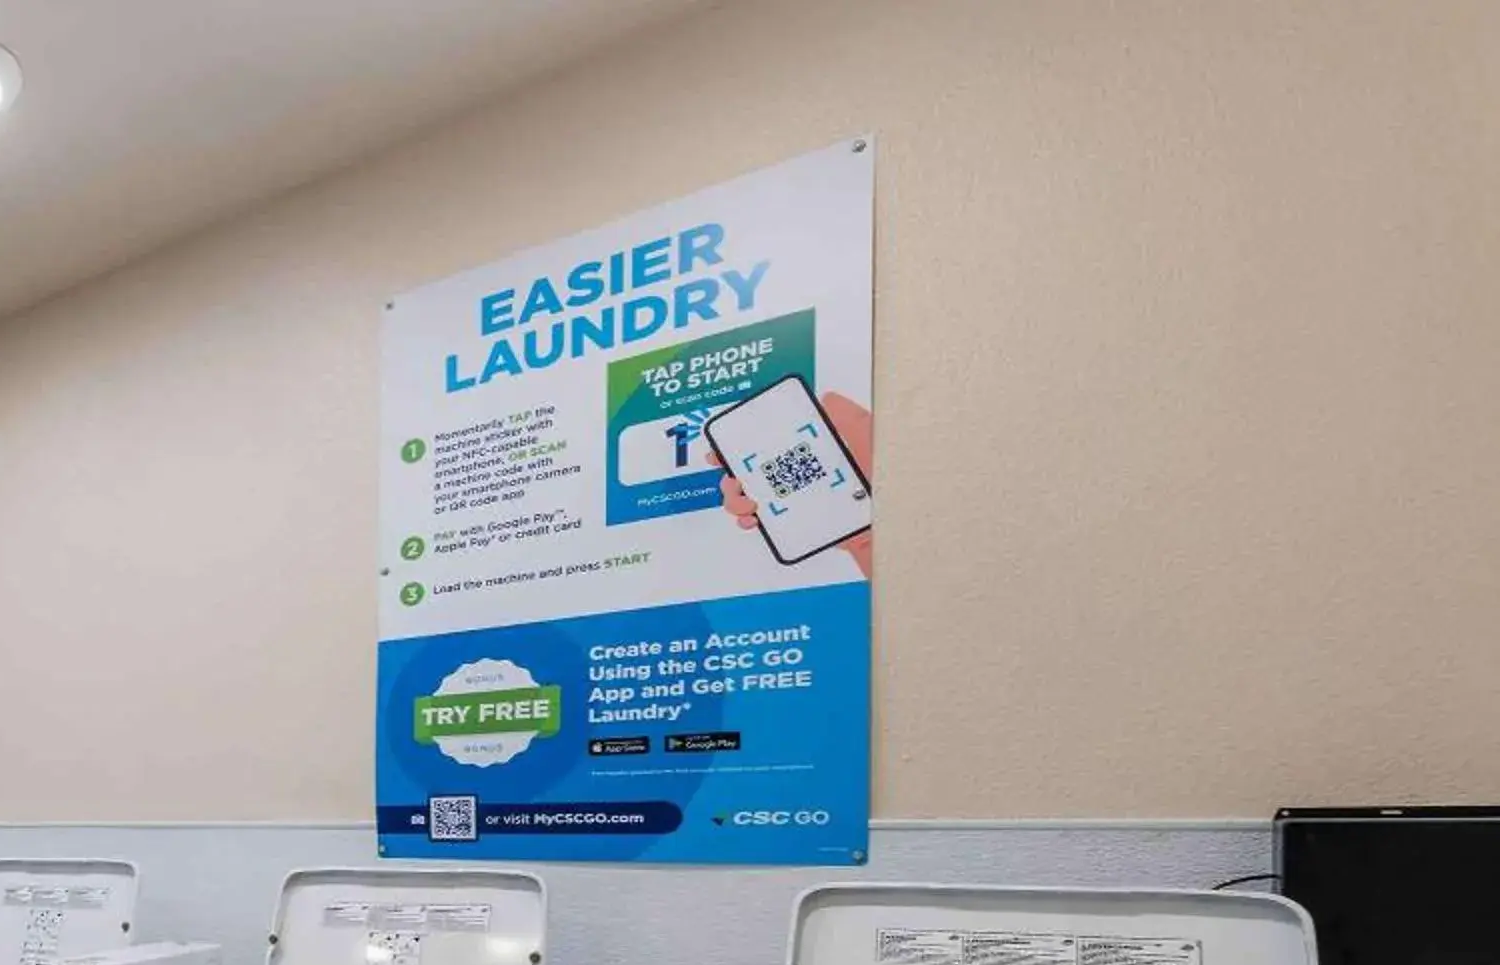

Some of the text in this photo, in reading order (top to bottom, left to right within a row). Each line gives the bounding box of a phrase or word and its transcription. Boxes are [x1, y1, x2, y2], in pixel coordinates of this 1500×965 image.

[481, 221, 725, 336] EASIER
[445, 259, 772, 393] LAUNDRY
[641, 338, 774, 384] TAP PHONE
[652, 357, 763, 397] TO START
[660, 385, 734, 409] or scan code
[434, 405, 555, 442] Momentarily TAP the
[434, 419, 553, 454] machine sticker with
[434, 436, 538, 469] your NFC-capable
[508, 451, 527, 462] OR
[530, 440, 567, 457] SCAN
[666, 422, 689, 468] 1
[434, 458, 553, 491] a machine code with
[434, 465, 581, 505] your smartphone camera
[434, 489, 525, 515] or QR code app
[434, 530, 457, 540] PAY
[460, 525, 484, 536] with
[487, 516, 530, 533] Google
[434, 541, 467, 554] Apple
[498, 533, 511, 542] or
[515, 525, 549, 539] credit
[553, 519, 582, 533] card
[433, 551, 652, 595] Load the machine and press START
[589, 624, 811, 661] Create an Account
[589, 648, 803, 681] Using the CSC GO
[588, 671, 812, 704] App and Get FREE
[421, 699, 550, 726] TRY FREE
[485, 812, 644, 829] or visit MyCSCGO.com
[733, 810, 830, 825] CSC GO
